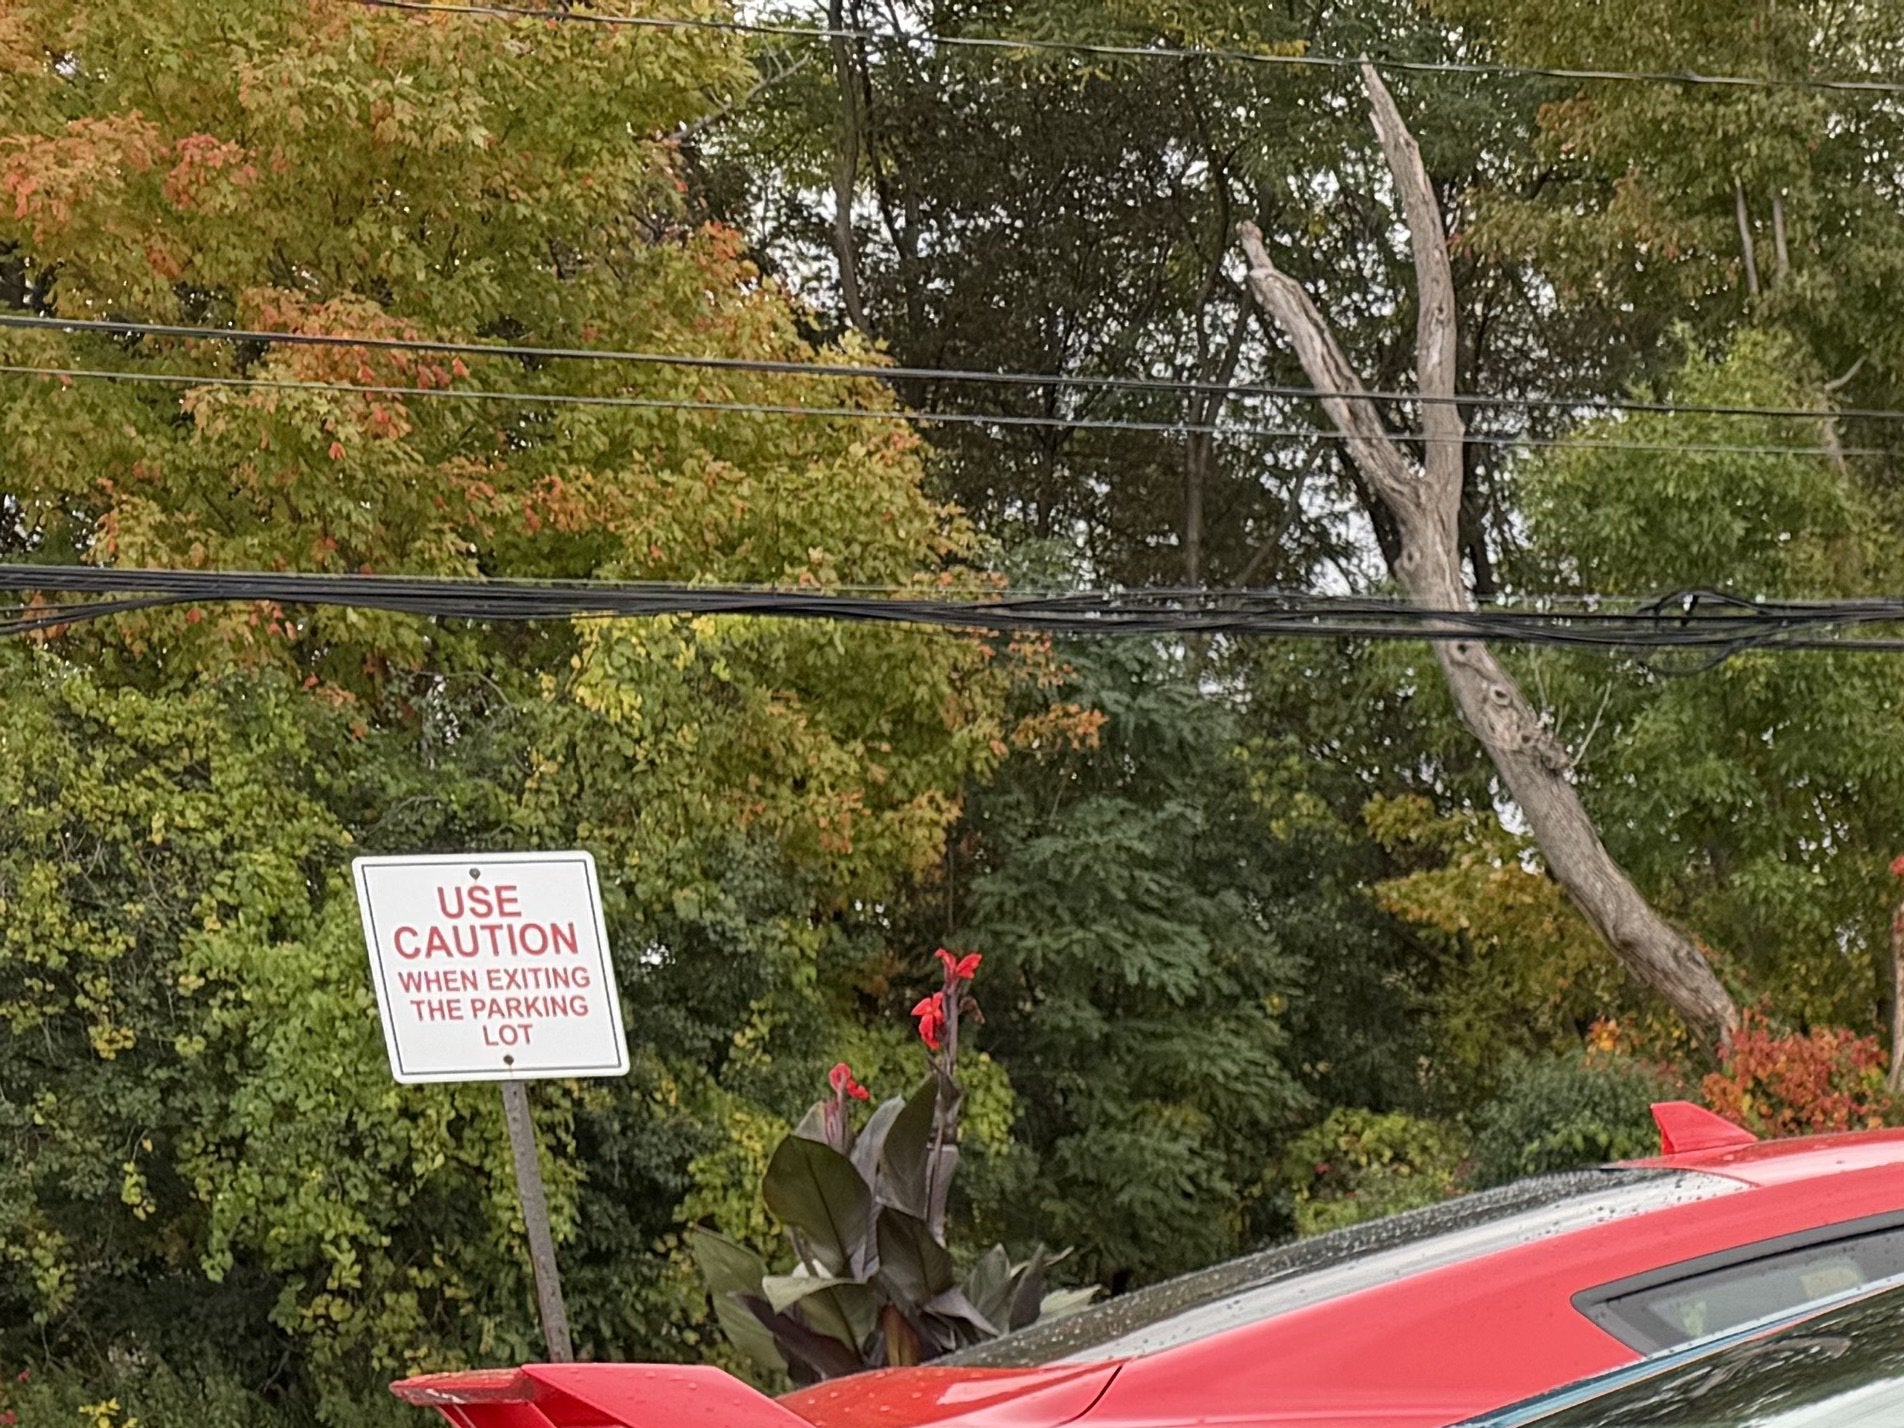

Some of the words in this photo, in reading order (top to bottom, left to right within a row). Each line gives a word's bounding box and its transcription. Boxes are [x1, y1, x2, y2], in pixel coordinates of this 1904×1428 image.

[437, 885, 522, 920] USE
[394, 922, 579, 960] CAUTION
[398, 970, 479, 993] WHEN
[486, 966, 591, 991] EXITING
[410, 999, 464, 1022] THE
[470, 995, 589, 1020] PARKING
[483, 1024, 533, 1046] LOT
